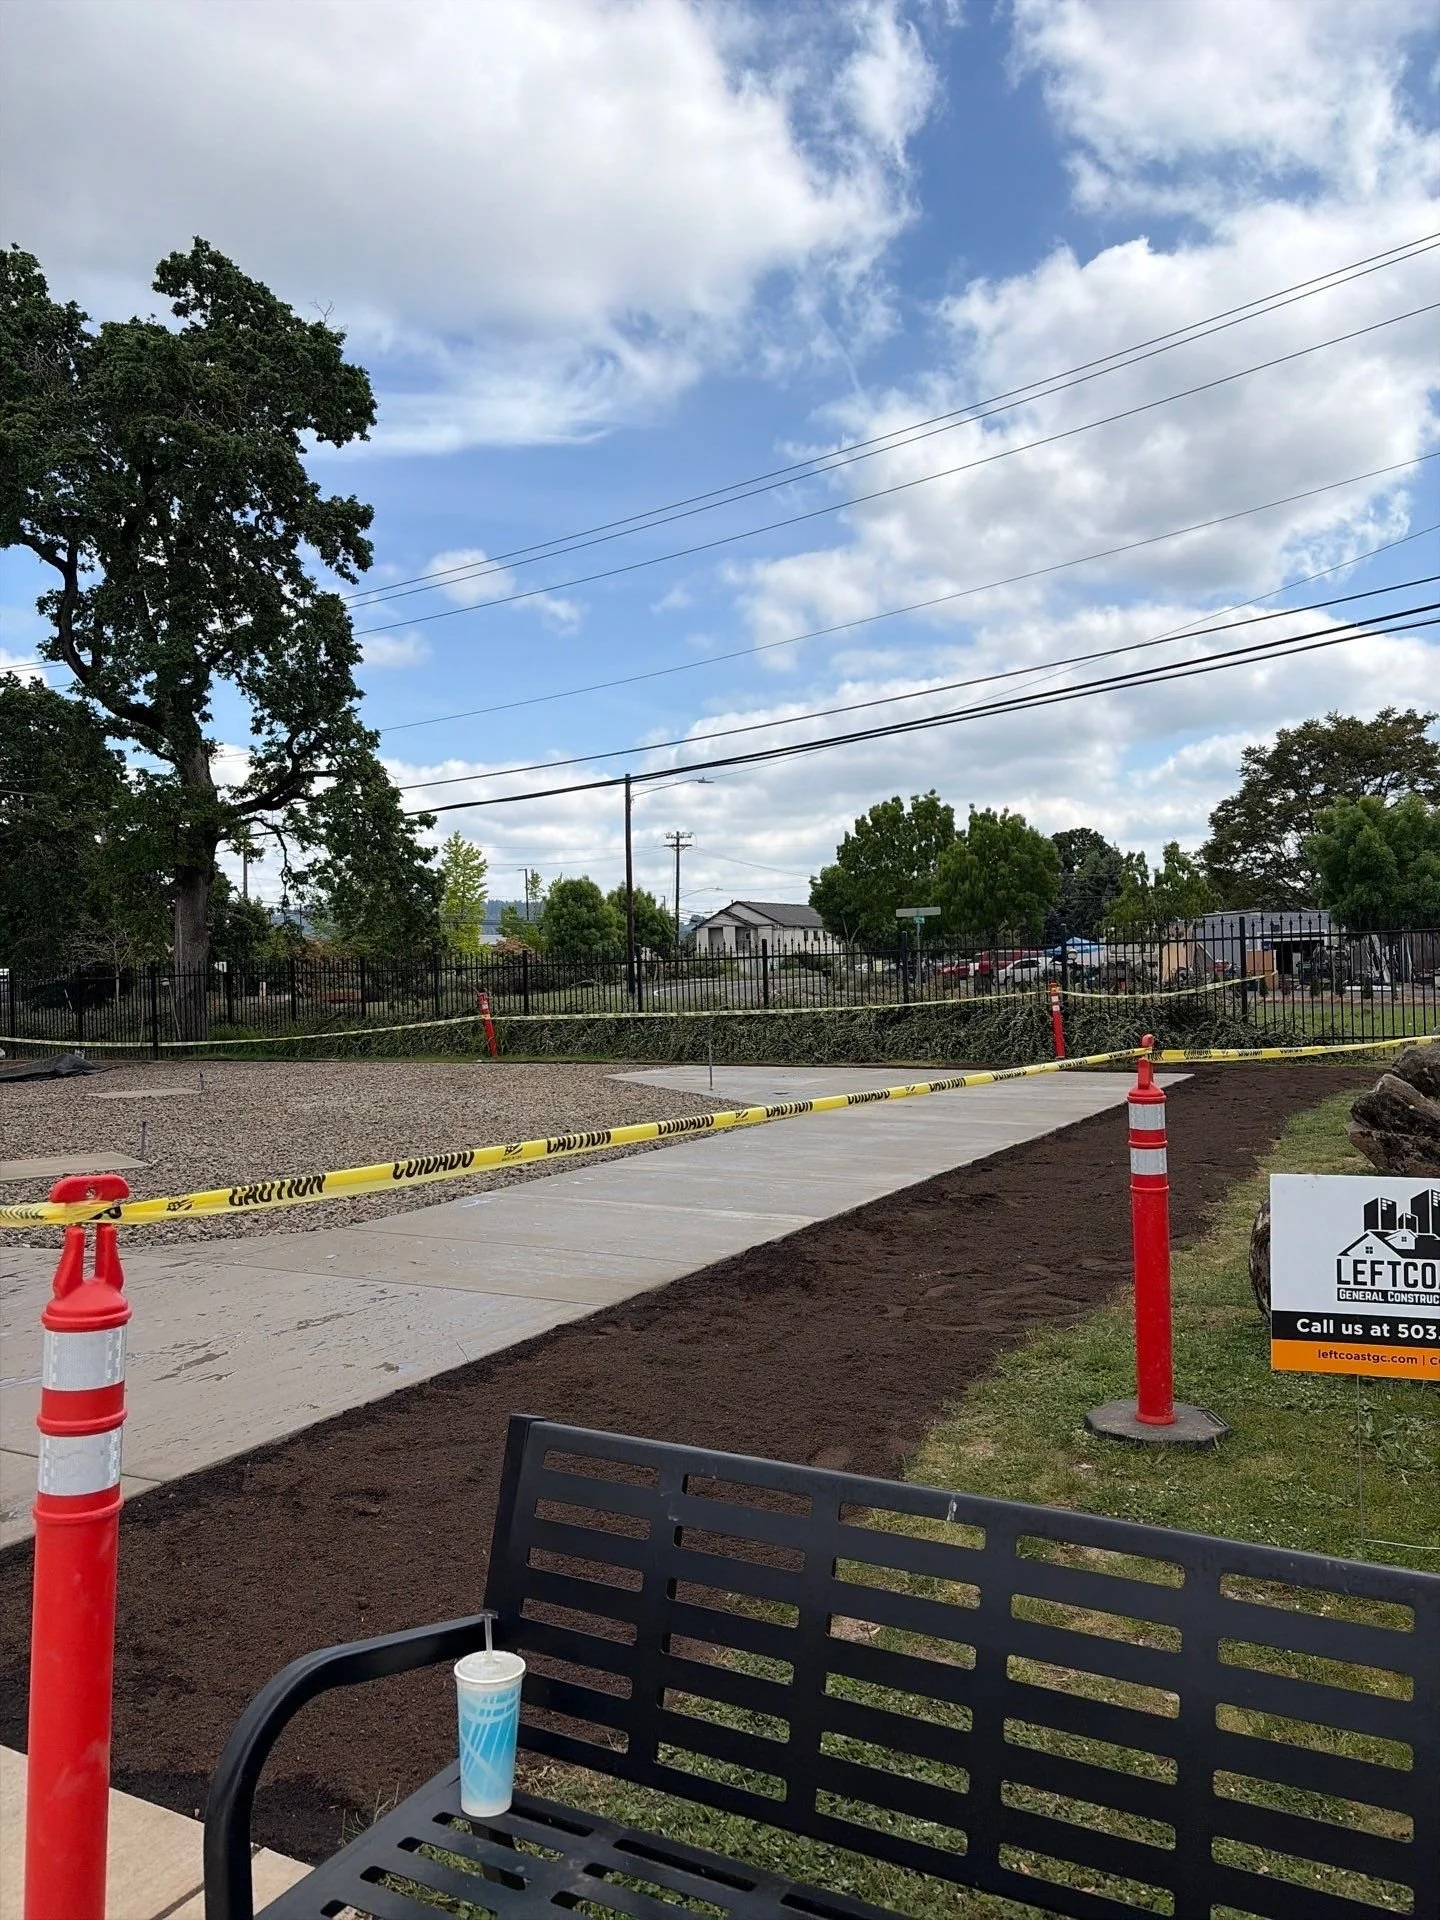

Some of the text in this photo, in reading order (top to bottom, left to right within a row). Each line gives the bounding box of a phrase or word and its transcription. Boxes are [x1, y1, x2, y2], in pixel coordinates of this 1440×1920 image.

[228, 1174, 326, 1207] CAUTION
[392, 1150, 475, 1180] CUIDADO
[546, 1130, 612, 1154] CAUTION
[657, 1114, 714, 1136] CUIDADO
[765, 1100, 813, 1118] CAUTION
[1336, 1258, 1440, 1290] LEFTCO
[1339, 1289, 1385, 1302] GENERAL
[1296, 1318, 1334, 1334] Call
[1341, 1323, 1364, 1336] us
[1370, 1323, 1391, 1338] at
[1317, 1349, 1418, 1365] leftcoastgc.com
